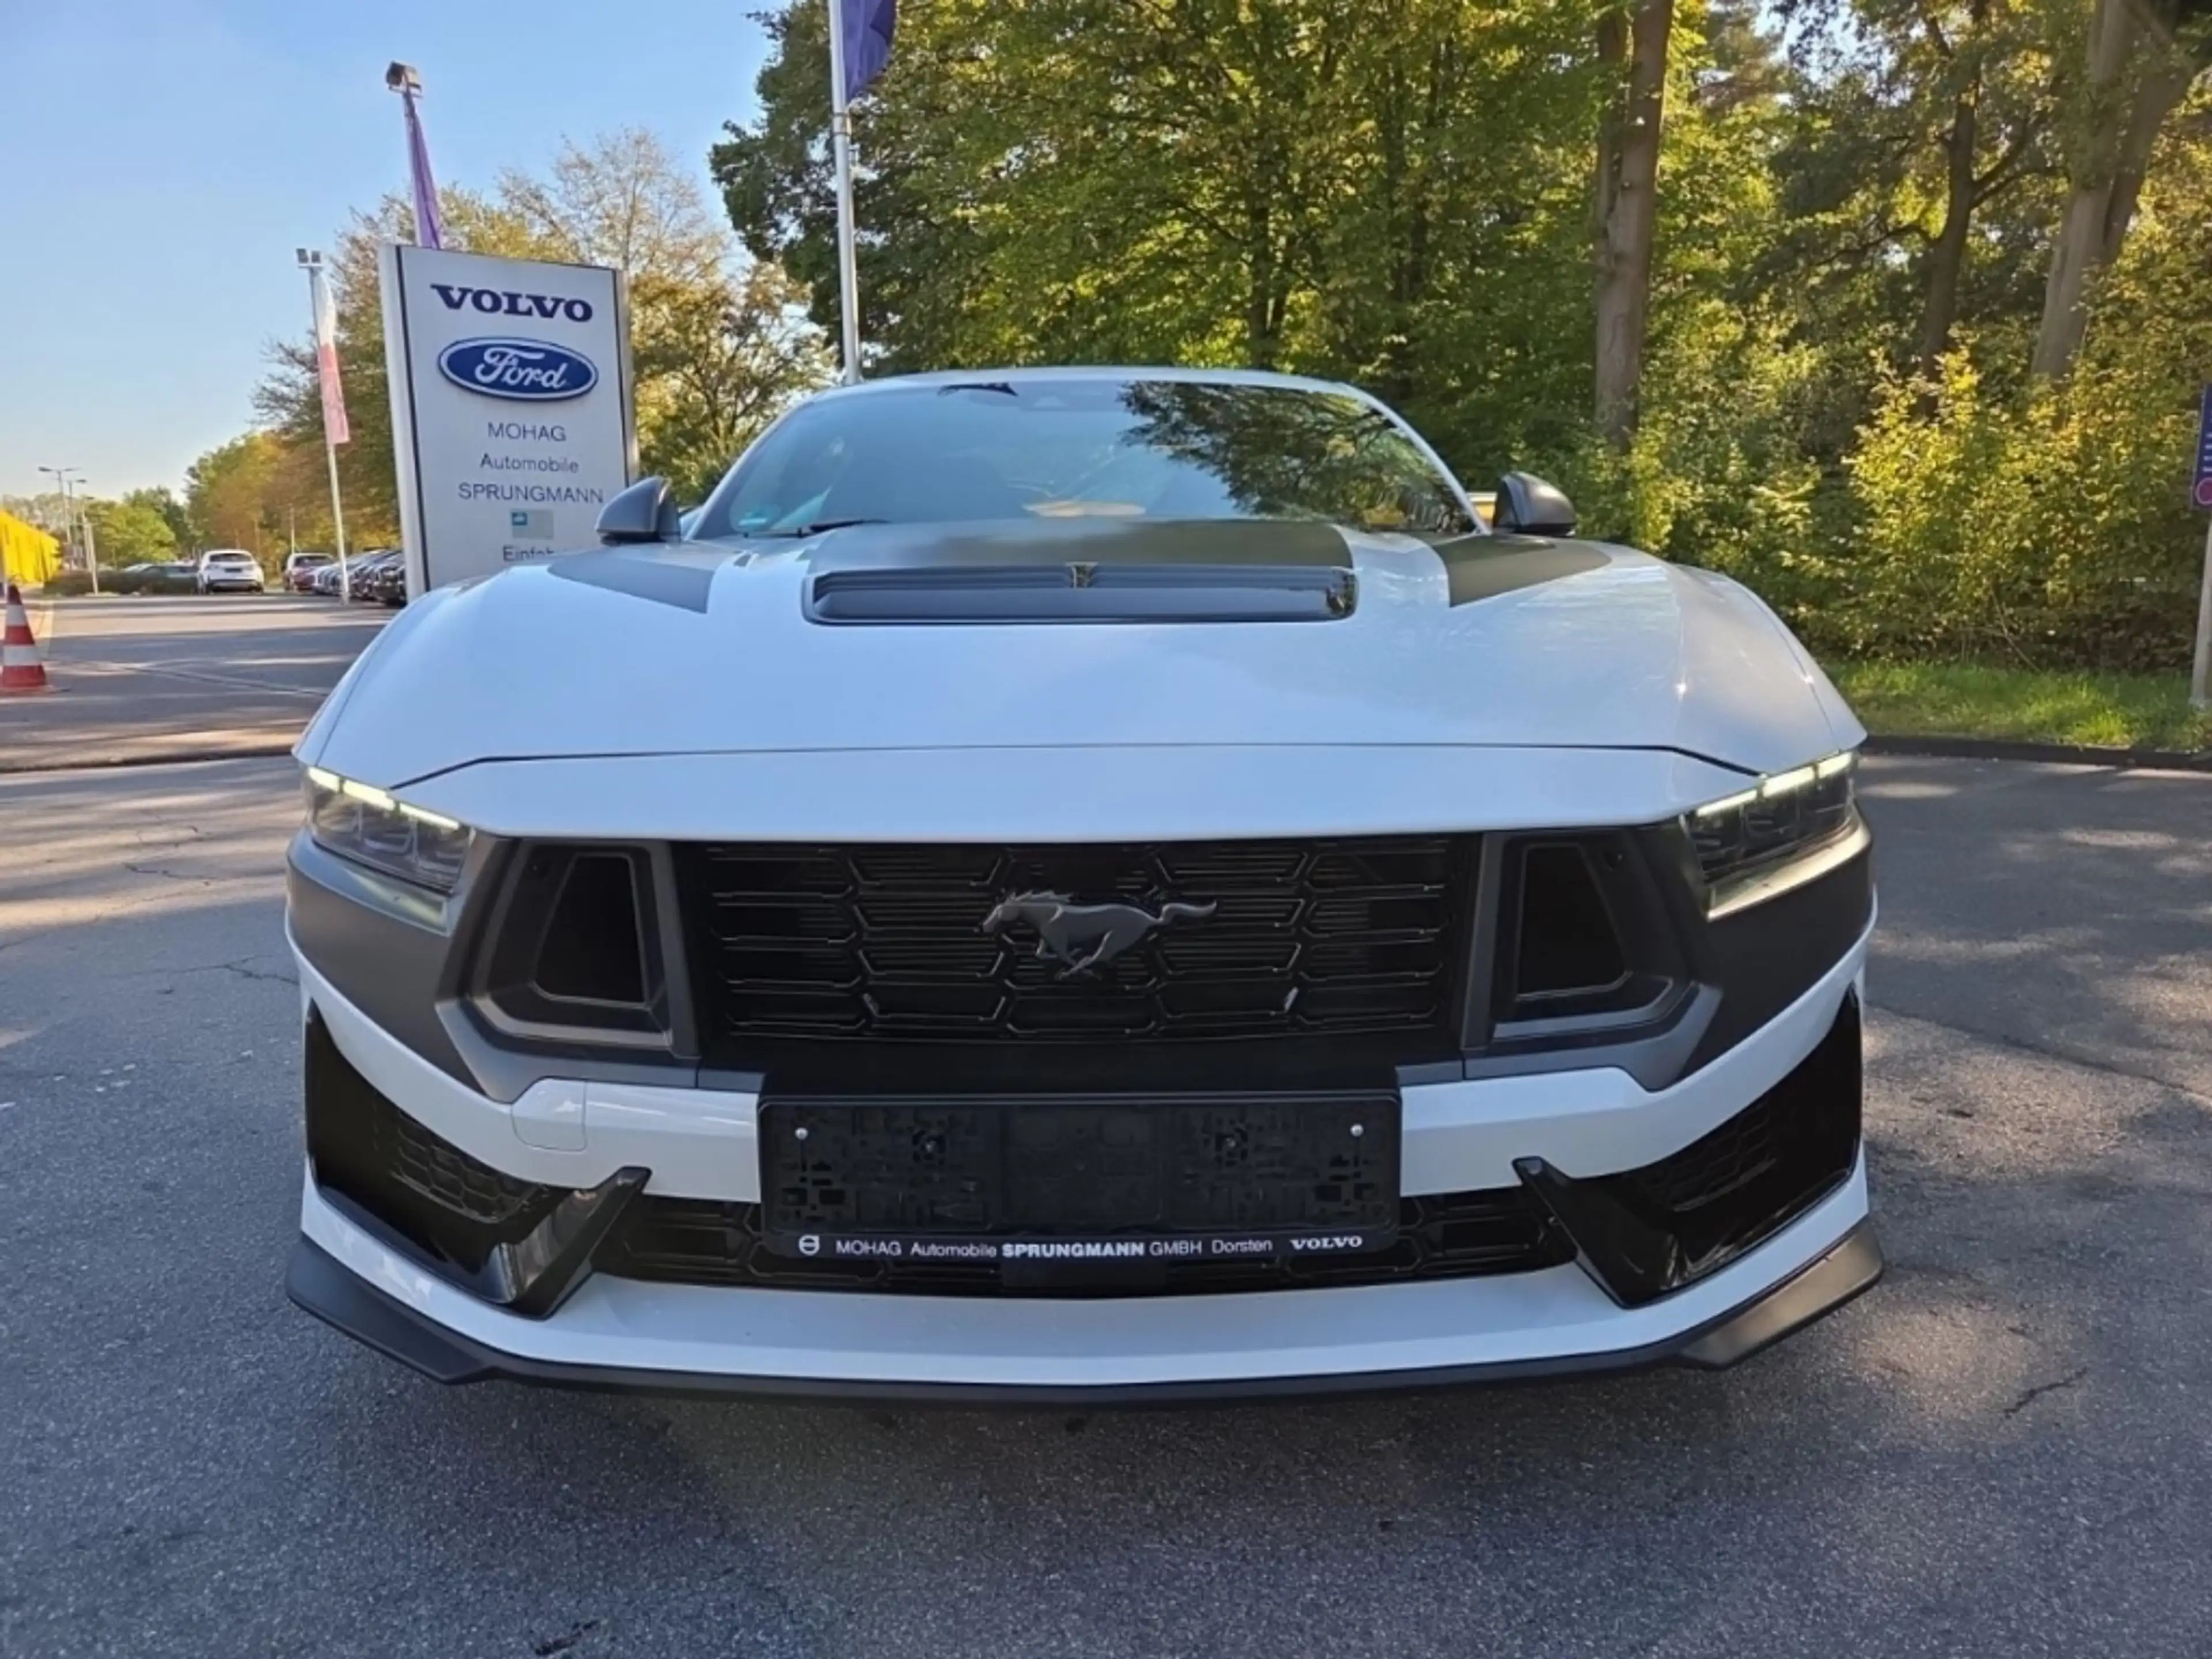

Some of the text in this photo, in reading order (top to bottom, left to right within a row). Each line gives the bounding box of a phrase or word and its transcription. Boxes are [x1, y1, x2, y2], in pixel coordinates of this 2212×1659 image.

[430, 285, 593, 323] VOLVO
[475, 347, 567, 389] Ford
[487, 422, 567, 442] MOHAG
[480, 453, 579, 474] Automobile
[458, 483, 604, 504] SPRUNGMANN
[836, 1236, 1363, 1257] MOHAG Automobile SPRUNGMANN GMBH Dorsten VOLVO
